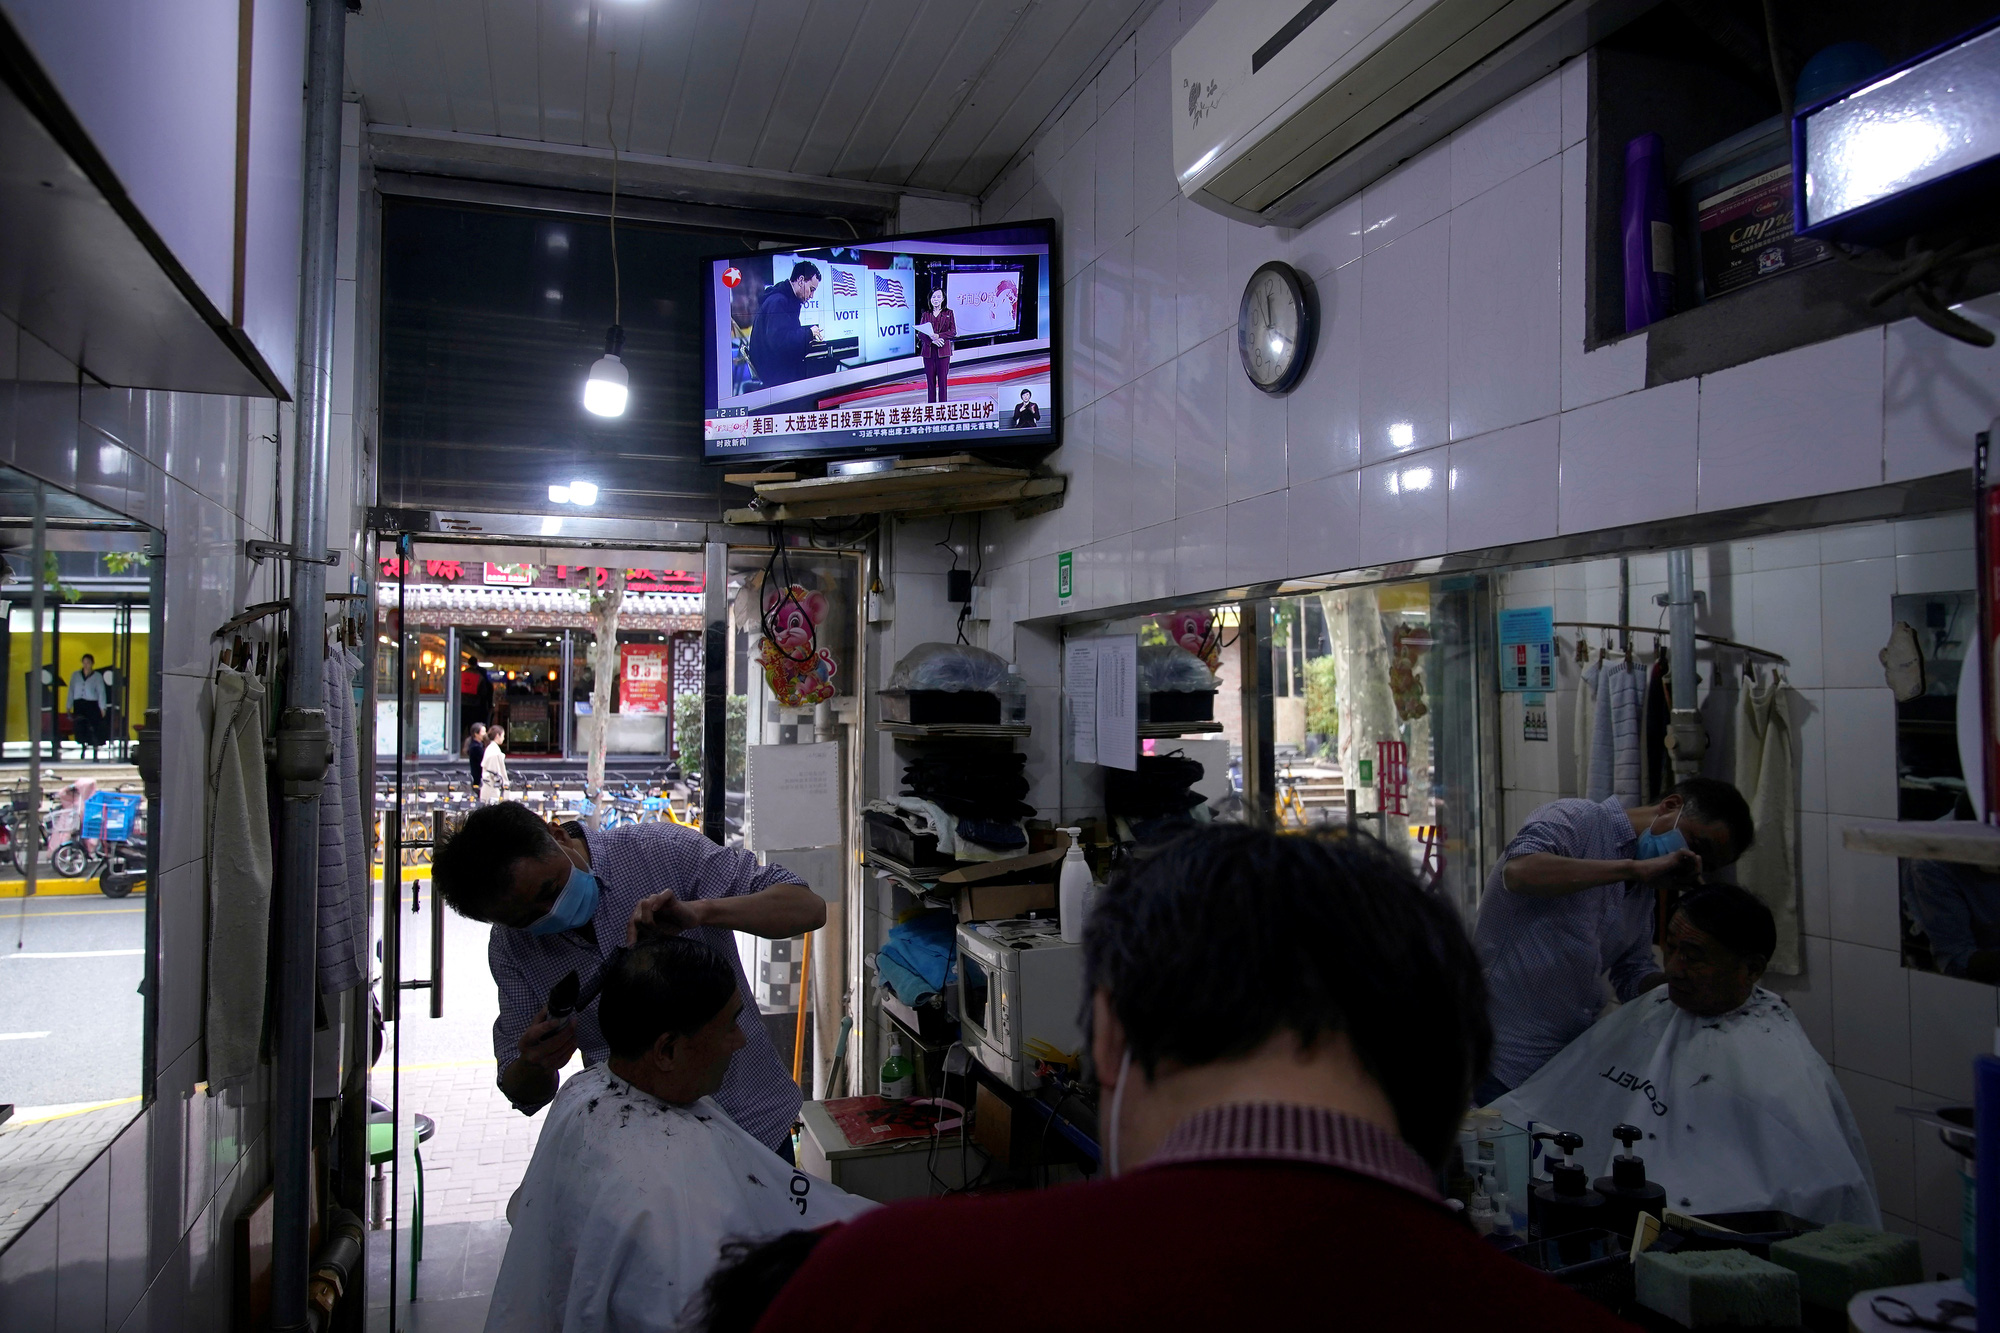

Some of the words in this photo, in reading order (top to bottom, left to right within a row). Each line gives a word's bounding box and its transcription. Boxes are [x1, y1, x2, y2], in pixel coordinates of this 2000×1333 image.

[1264, 278, 1274, 296] 12
[803, 300, 819, 309] OTE
[880, 323, 910, 337] VOTE
[1248, 333, 1255, 349] 9
[1255, 348, 1262, 367] 8
[1265, 360, 1271, 379] 7
[716, 407, 746, 418] 12:16
[889, 401, 994, 425] 选举结果或延迟出炉
[716, 438, 747, 448] 时政新闻
